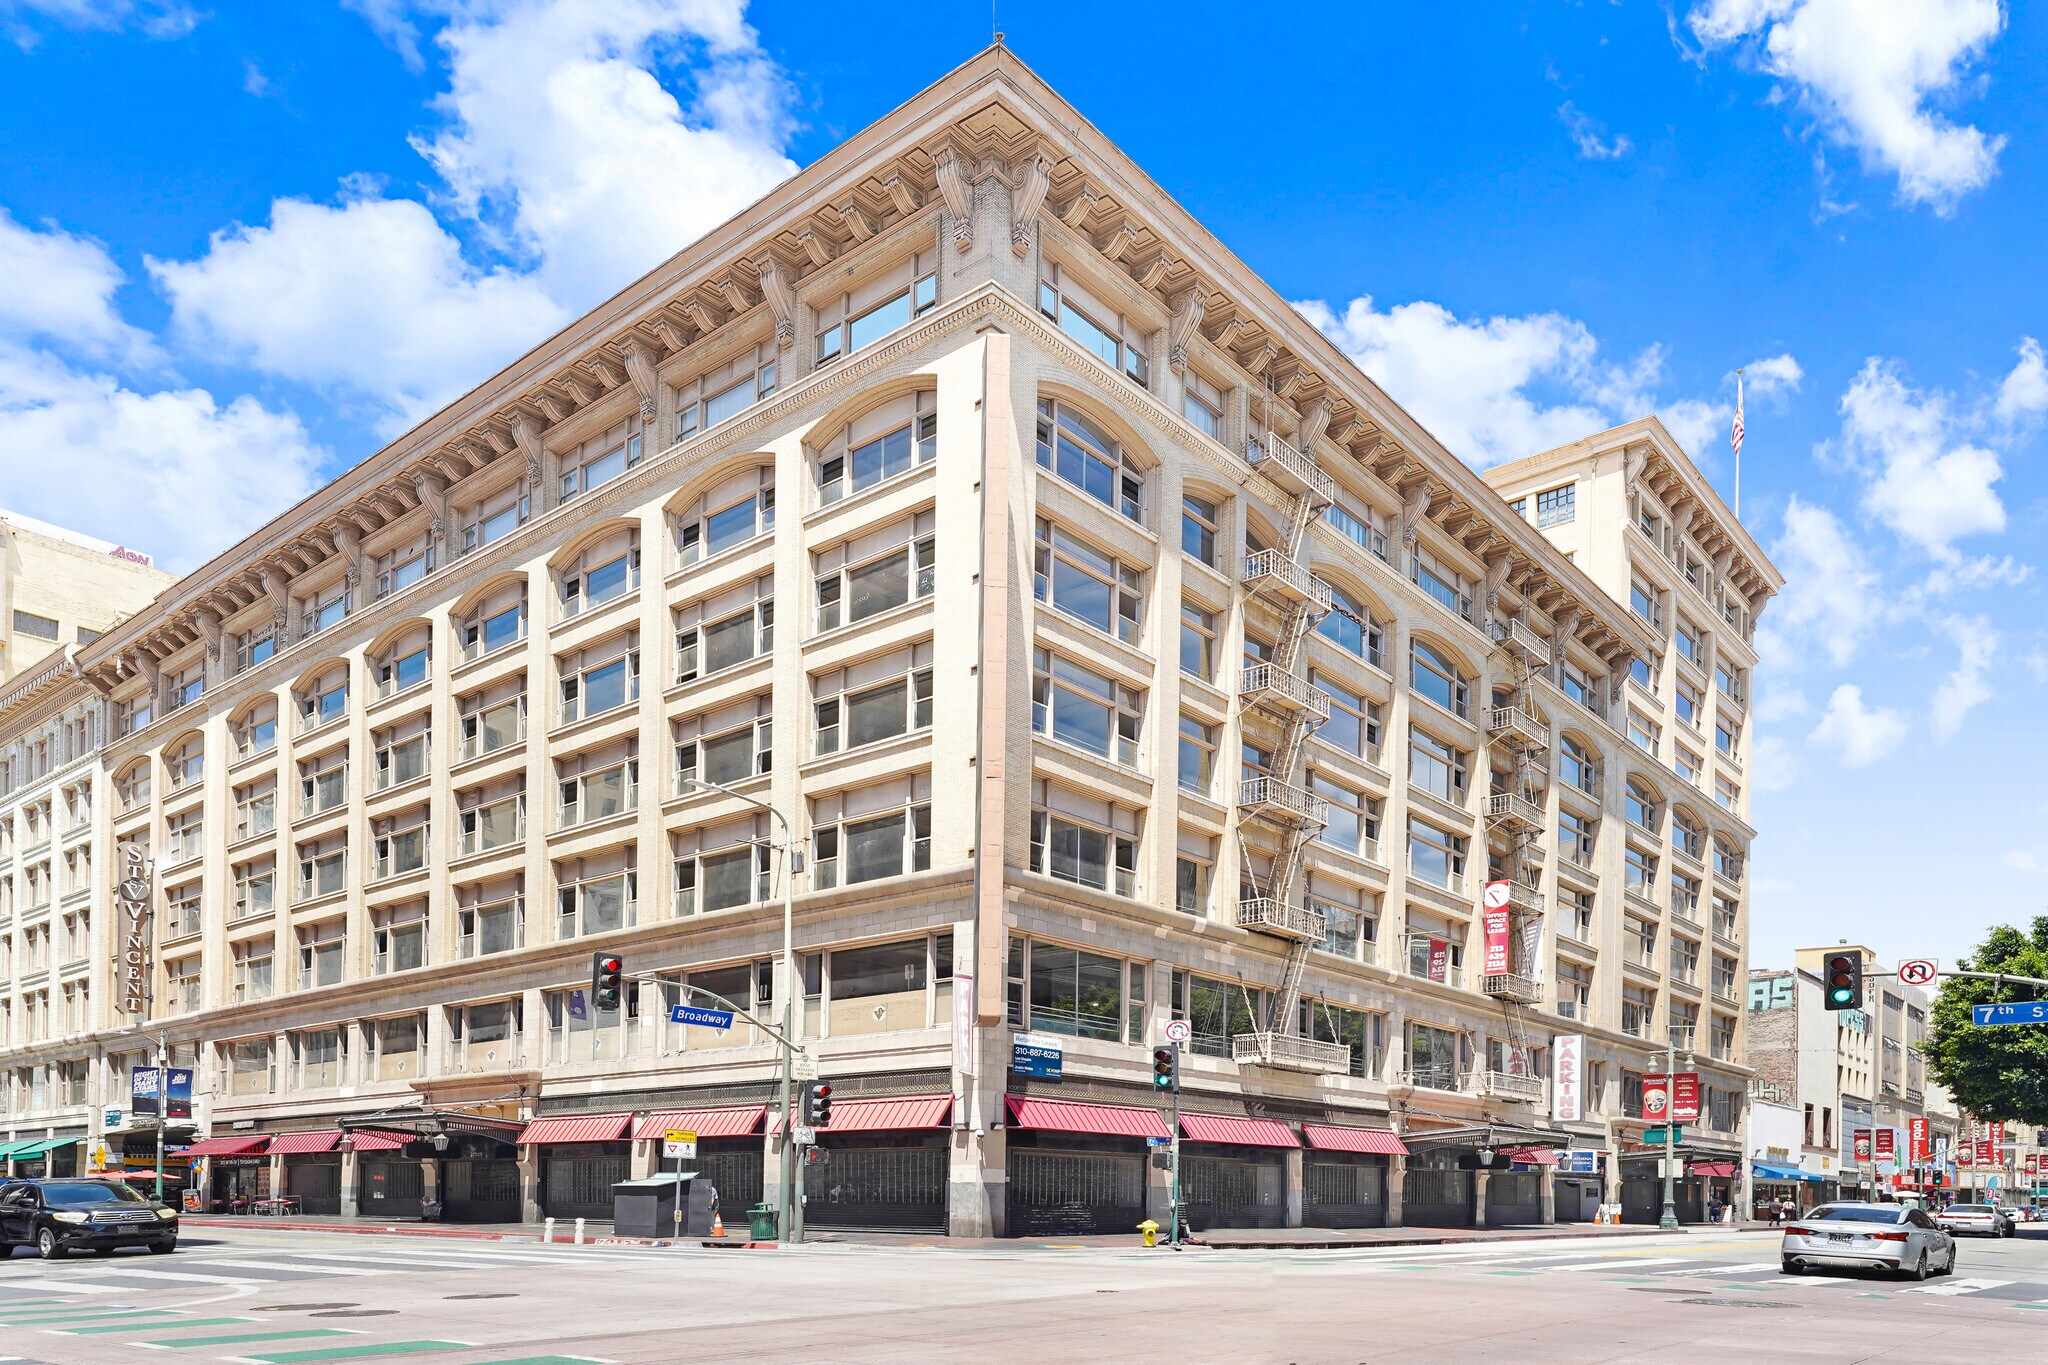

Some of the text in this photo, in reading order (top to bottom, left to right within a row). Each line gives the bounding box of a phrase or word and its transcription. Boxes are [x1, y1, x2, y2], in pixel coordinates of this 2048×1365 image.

[123, 901, 147, 1011] VINCENT
[1488, 952, 1505, 960] 629
[1489, 945, 1505, 953] 213
[677, 1009, 728, 1027] Broadway
[1978, 1006, 2048, 1023] 7th S
[1015, 1046, 1060, 1060] 310-887-6226
[134, 1070, 158, 1079] NIGHT
[1559, 1037, 1576, 1119] PARKING
[134, 1079, 158, 1087] MANY
[1913, 1120, 1926, 1141] total
